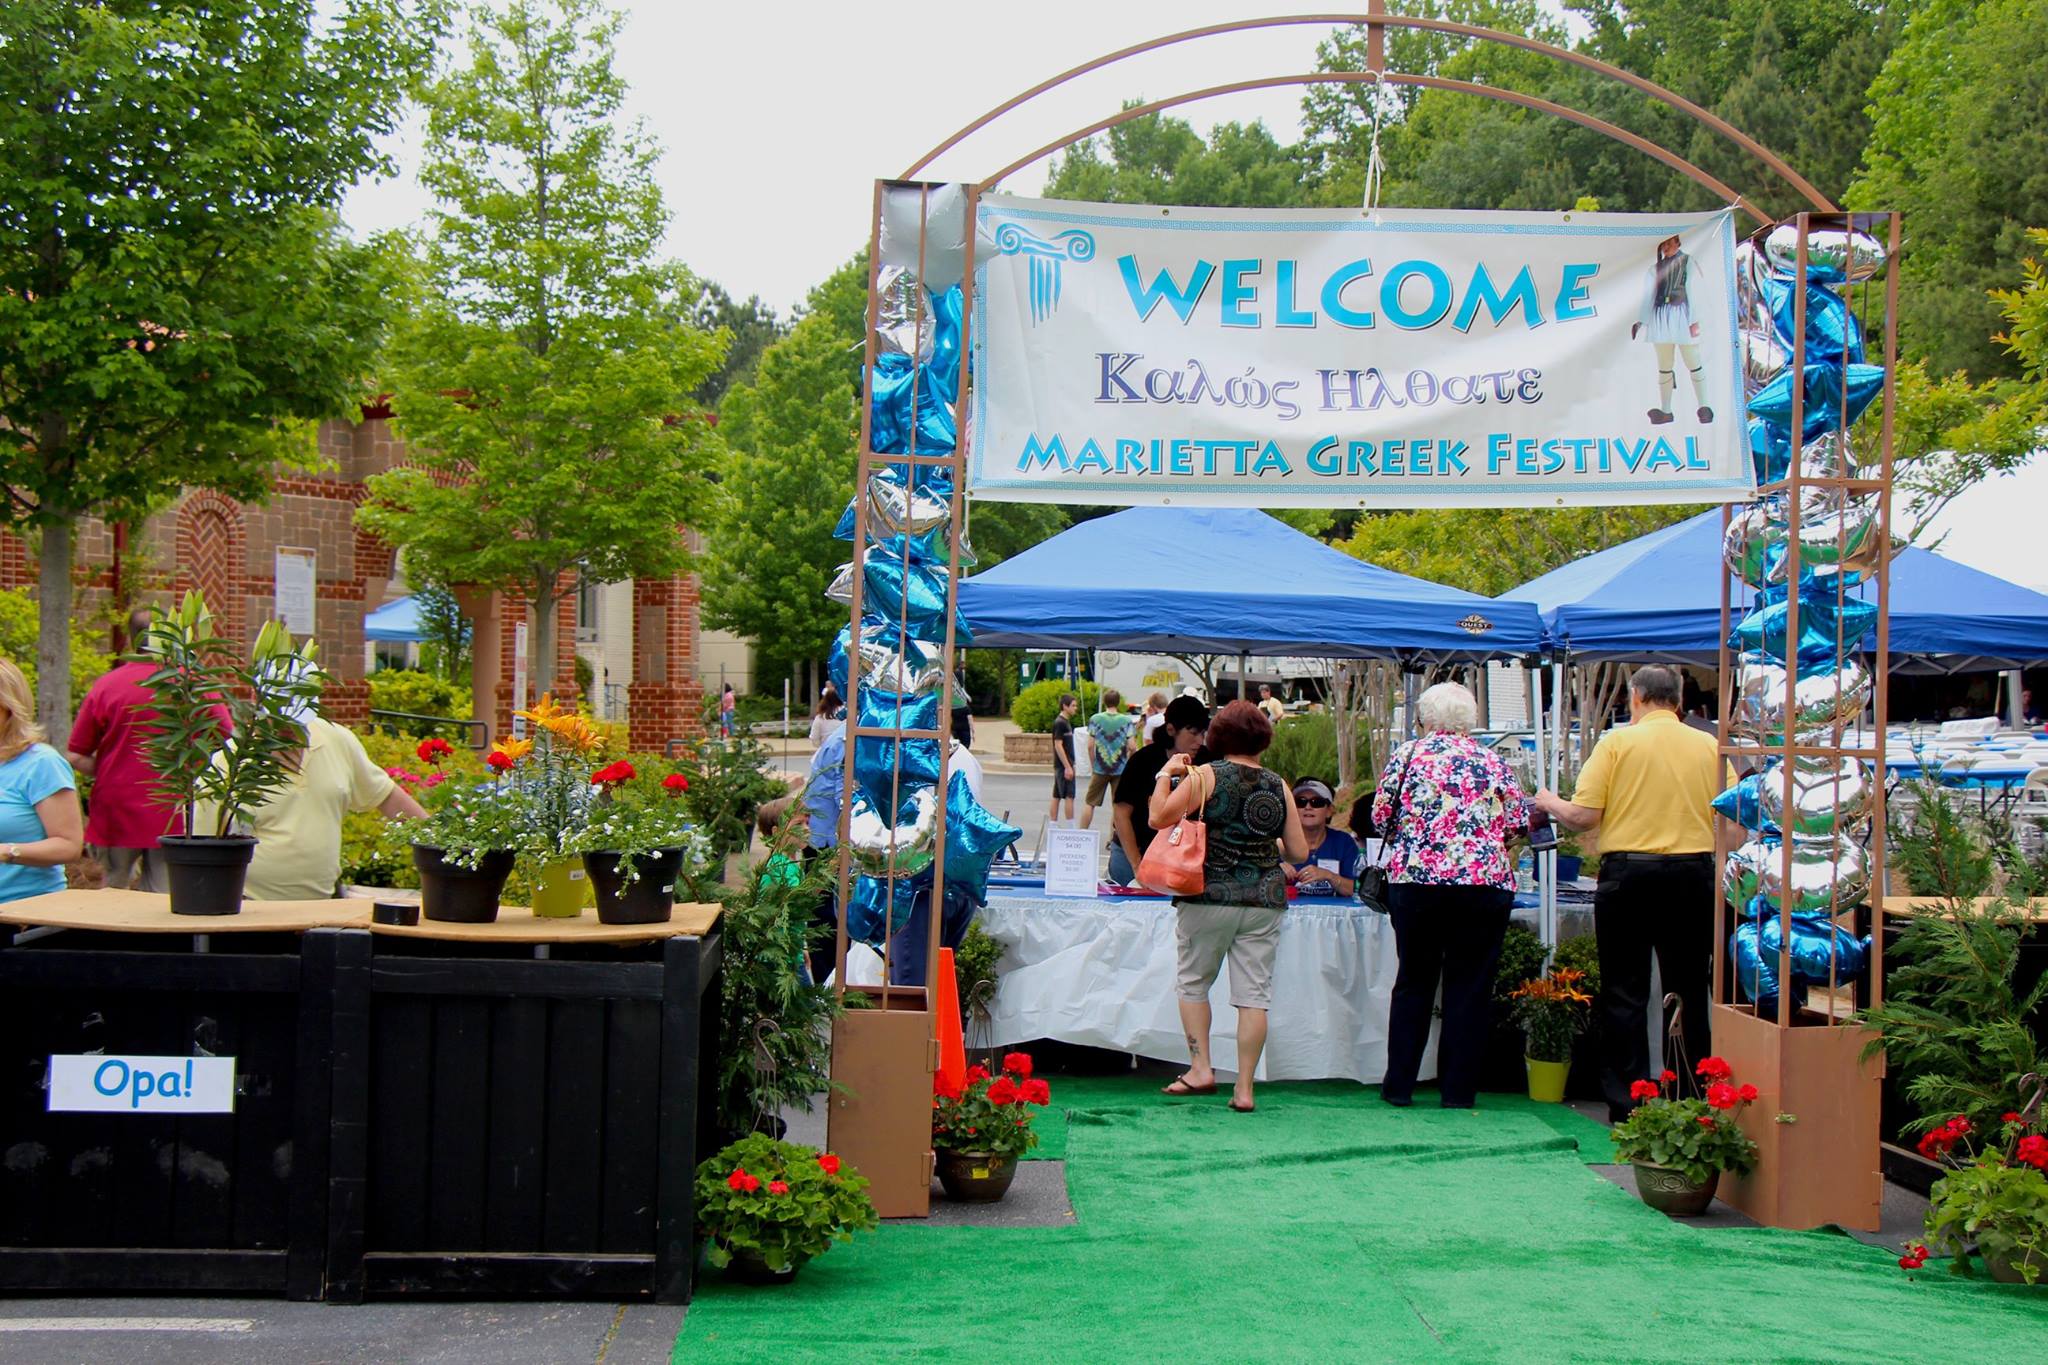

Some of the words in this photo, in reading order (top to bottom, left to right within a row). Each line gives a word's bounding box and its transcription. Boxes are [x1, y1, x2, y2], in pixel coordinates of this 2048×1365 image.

[1116, 254, 1602, 335] WELCOME
[1094, 352, 1301, 420] Καλώς
[1017, 432, 1294, 478] MARIETTA
[1307, 434, 1472, 477] GREEK
[1487, 432, 1711, 477] FESTIVAL
[1461, 621, 1488, 629] QUEST
[94, 1059, 193, 1109] Opa!
